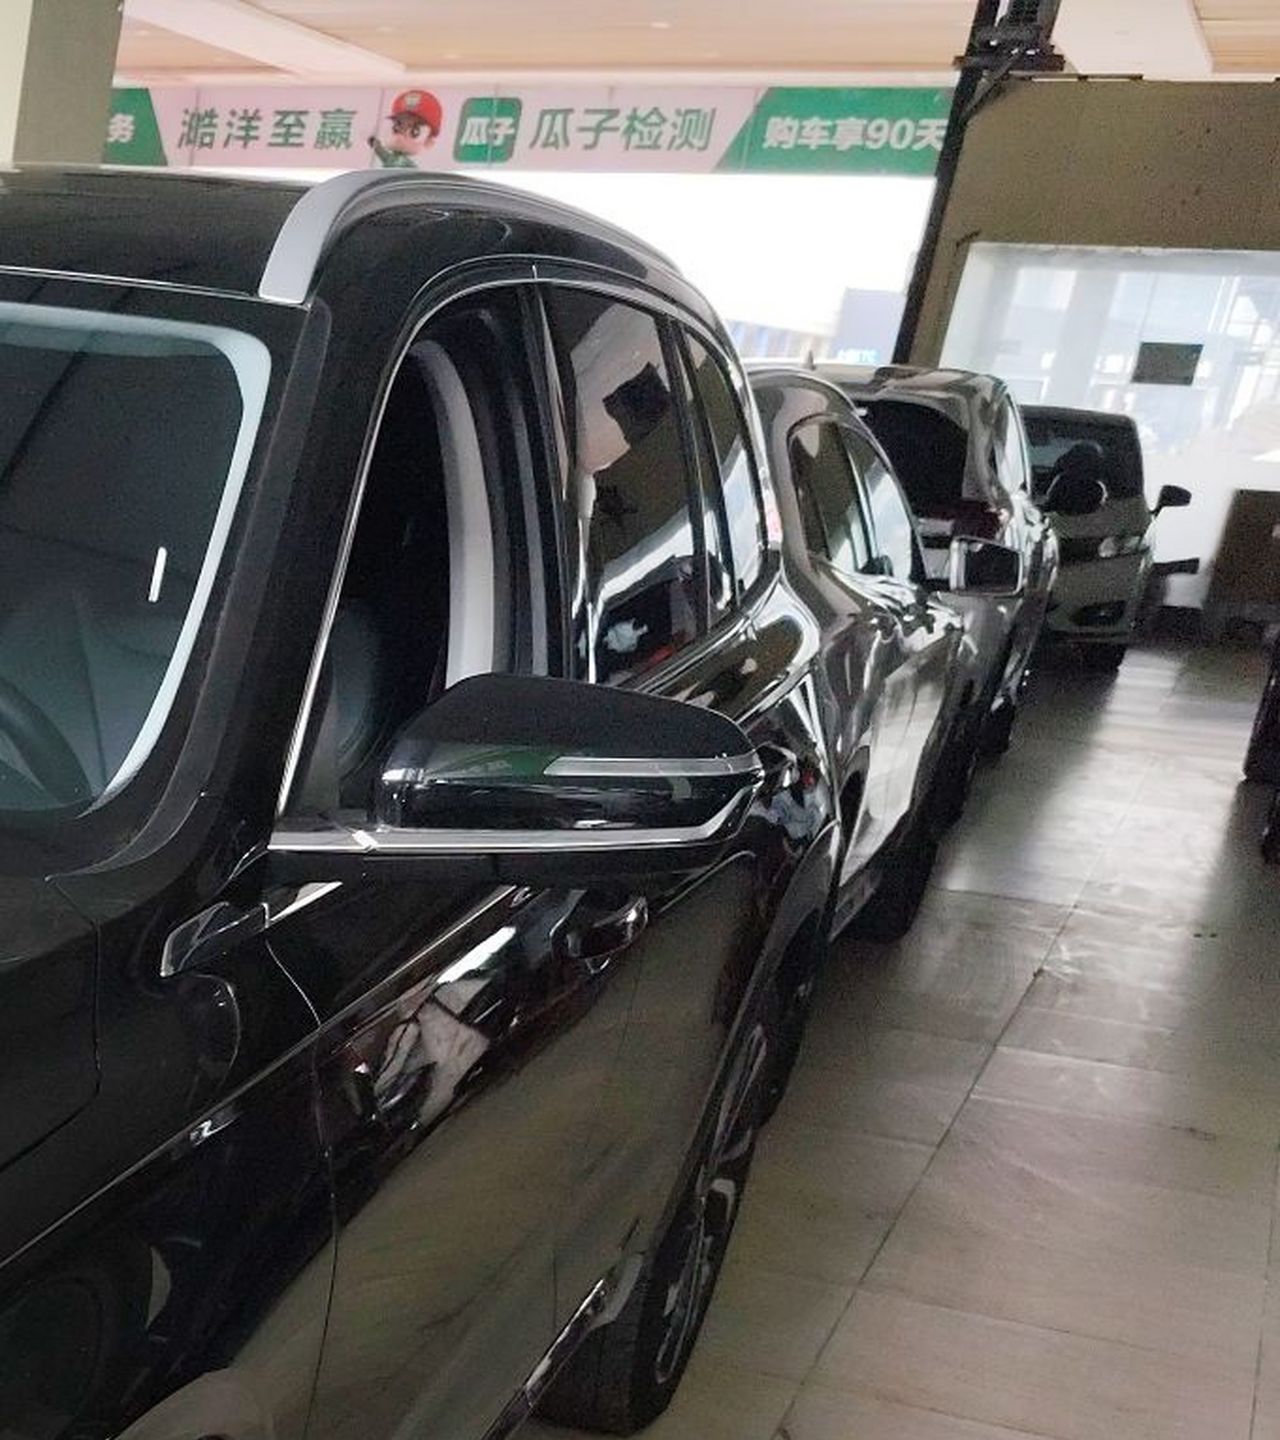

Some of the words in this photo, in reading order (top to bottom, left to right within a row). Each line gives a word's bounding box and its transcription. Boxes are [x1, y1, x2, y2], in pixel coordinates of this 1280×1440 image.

[459, 116, 516, 147] 瓜子
[528, 106, 717, 151] 瓜子检测
[762, 116, 949, 151] 购车享90天
